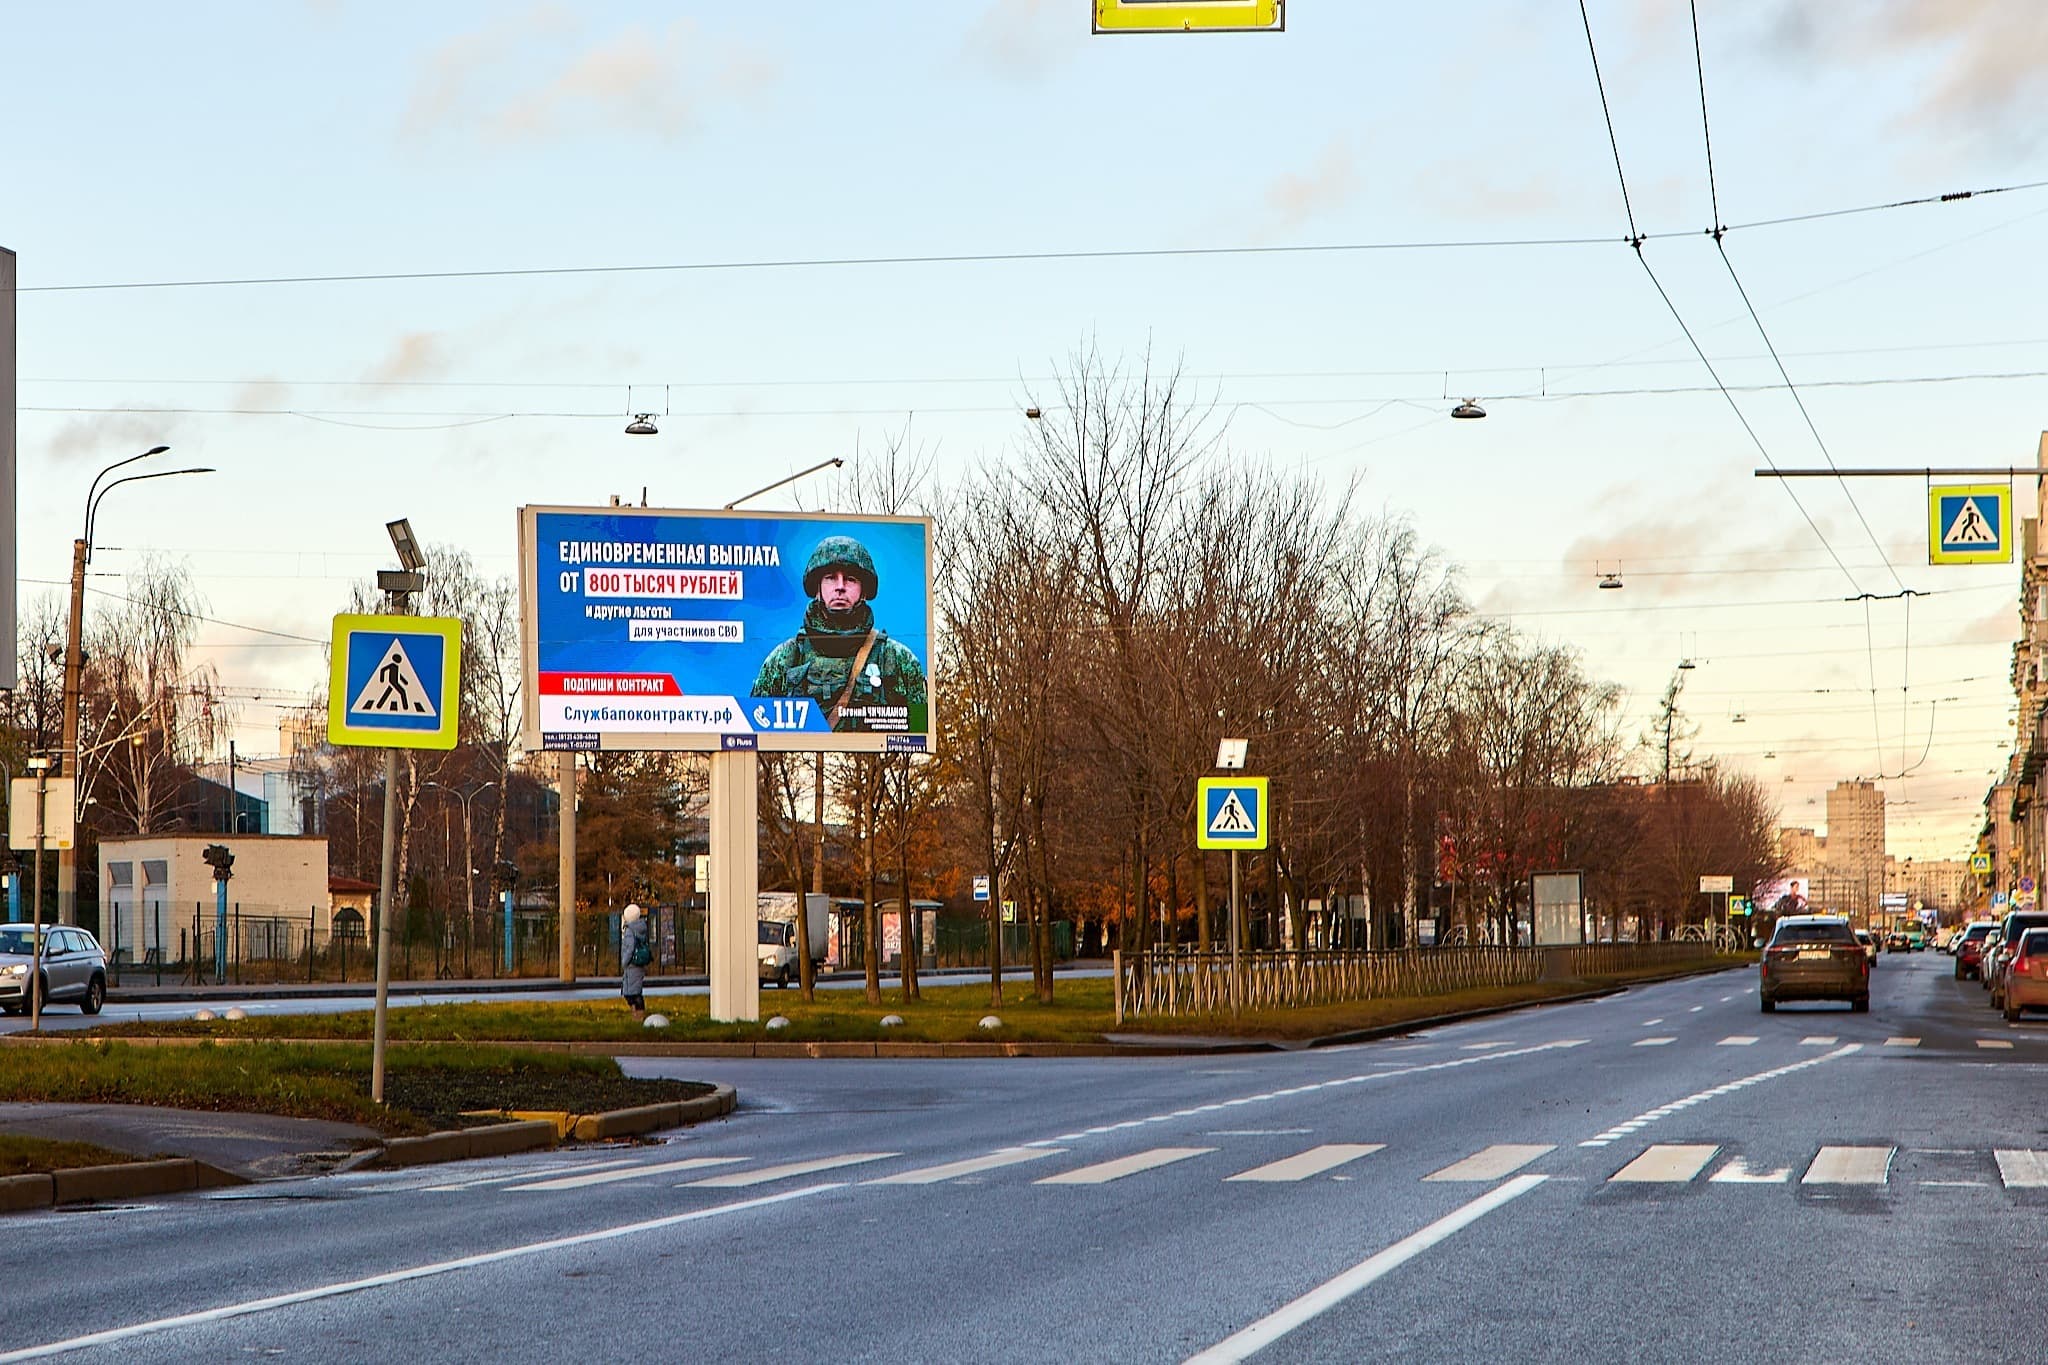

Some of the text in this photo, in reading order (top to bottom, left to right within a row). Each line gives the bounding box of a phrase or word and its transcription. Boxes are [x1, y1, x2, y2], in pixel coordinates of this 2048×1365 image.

[560, 541, 780, 567] ЕДИНОВРЕМЕННАЯ ВЫПЛАТА
[560, 571, 738, 595] ОТ 800 ТЫСЯЧ РУБЛЕЙ
[585, 605, 672, 620] и другие льготы
[633, 625, 738, 640] для участников СВО
[563, 678, 665, 694] ПОДПИШИ КОНТРАКТ
[564, 705, 733, 725] Службапоконтракту.рф
[773, 700, 810, 729] 117
